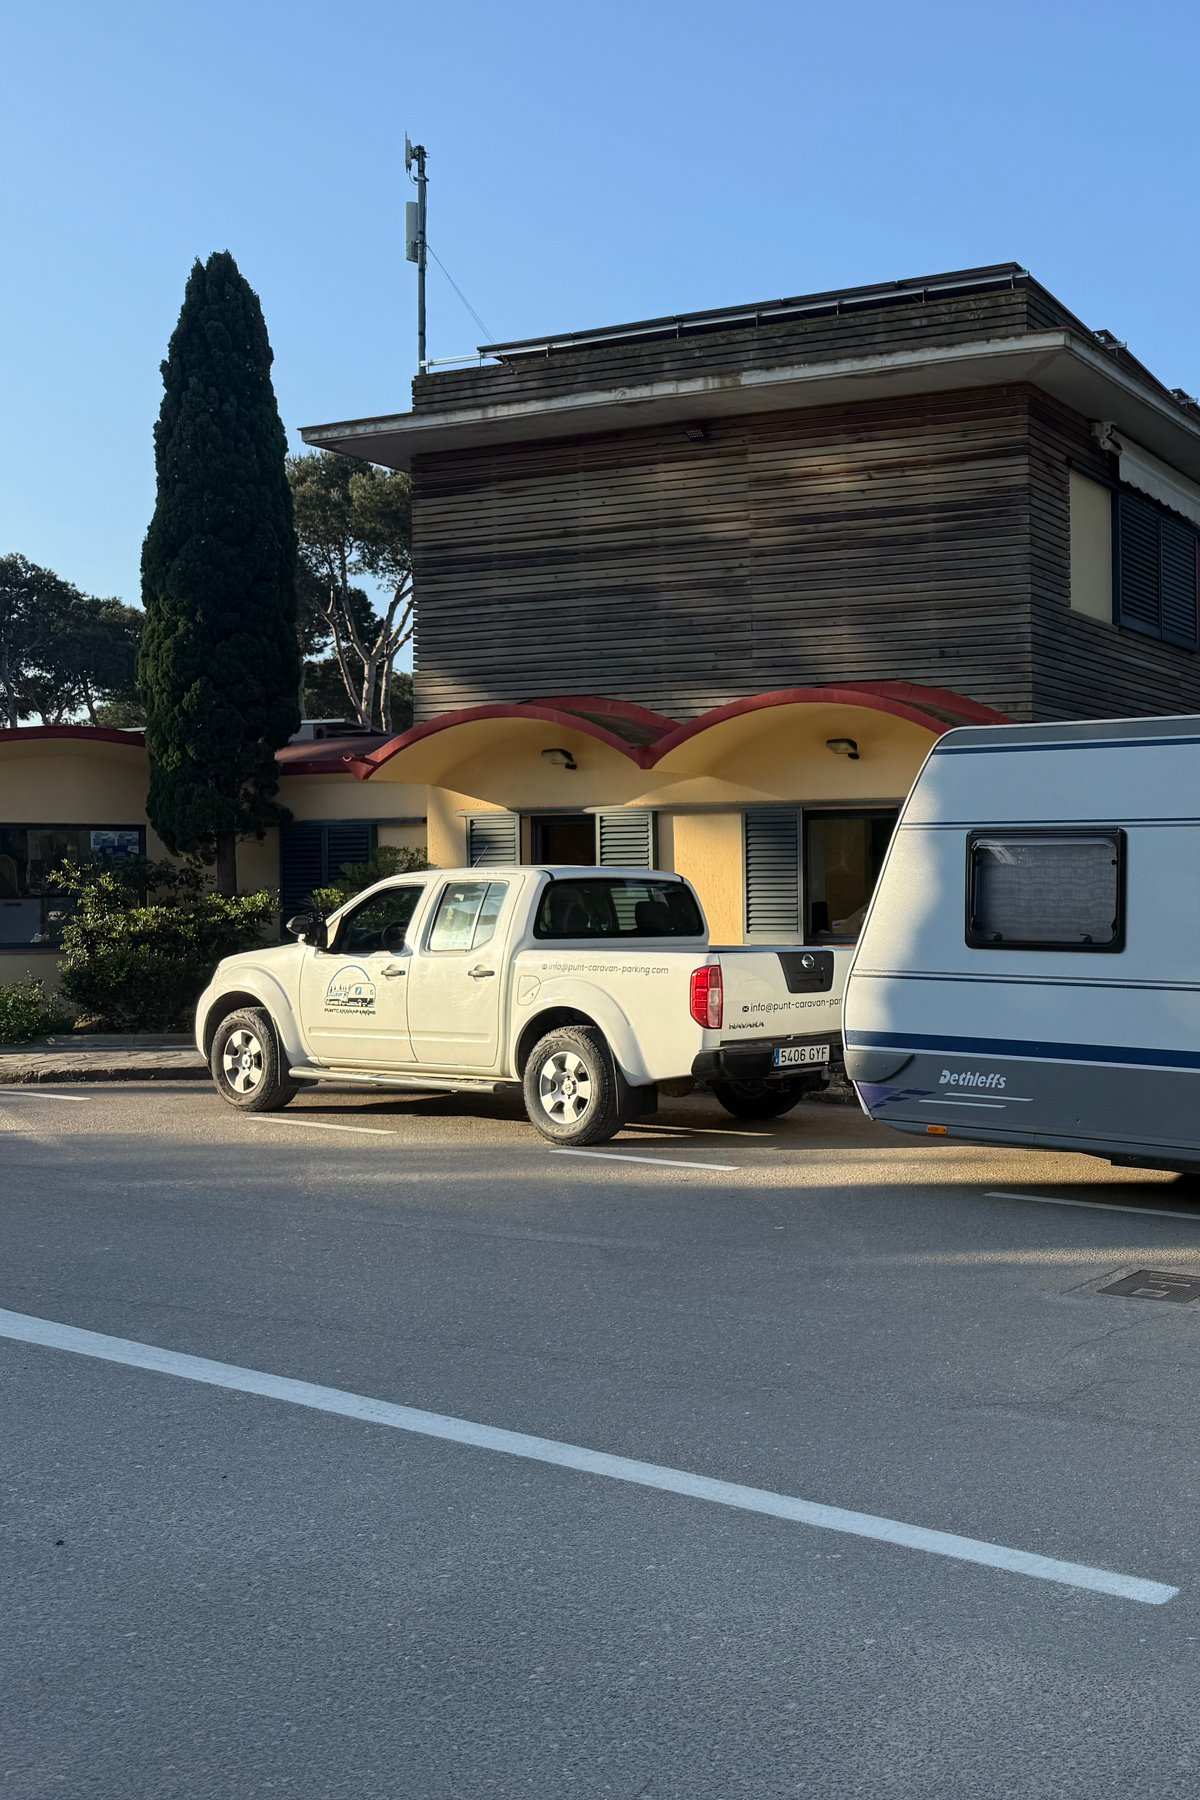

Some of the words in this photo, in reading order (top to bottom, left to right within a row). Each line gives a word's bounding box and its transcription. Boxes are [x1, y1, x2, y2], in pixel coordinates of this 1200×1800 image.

[549, 962, 669, 976] info@punt-caravan-parking.com
[728, 1021, 765, 1030] NAVARA
[781, 1048, 806, 1063] 5406
[809, 1046, 827, 1061] GYF
[939, 1069, 1007, 1089] Dethleffs
